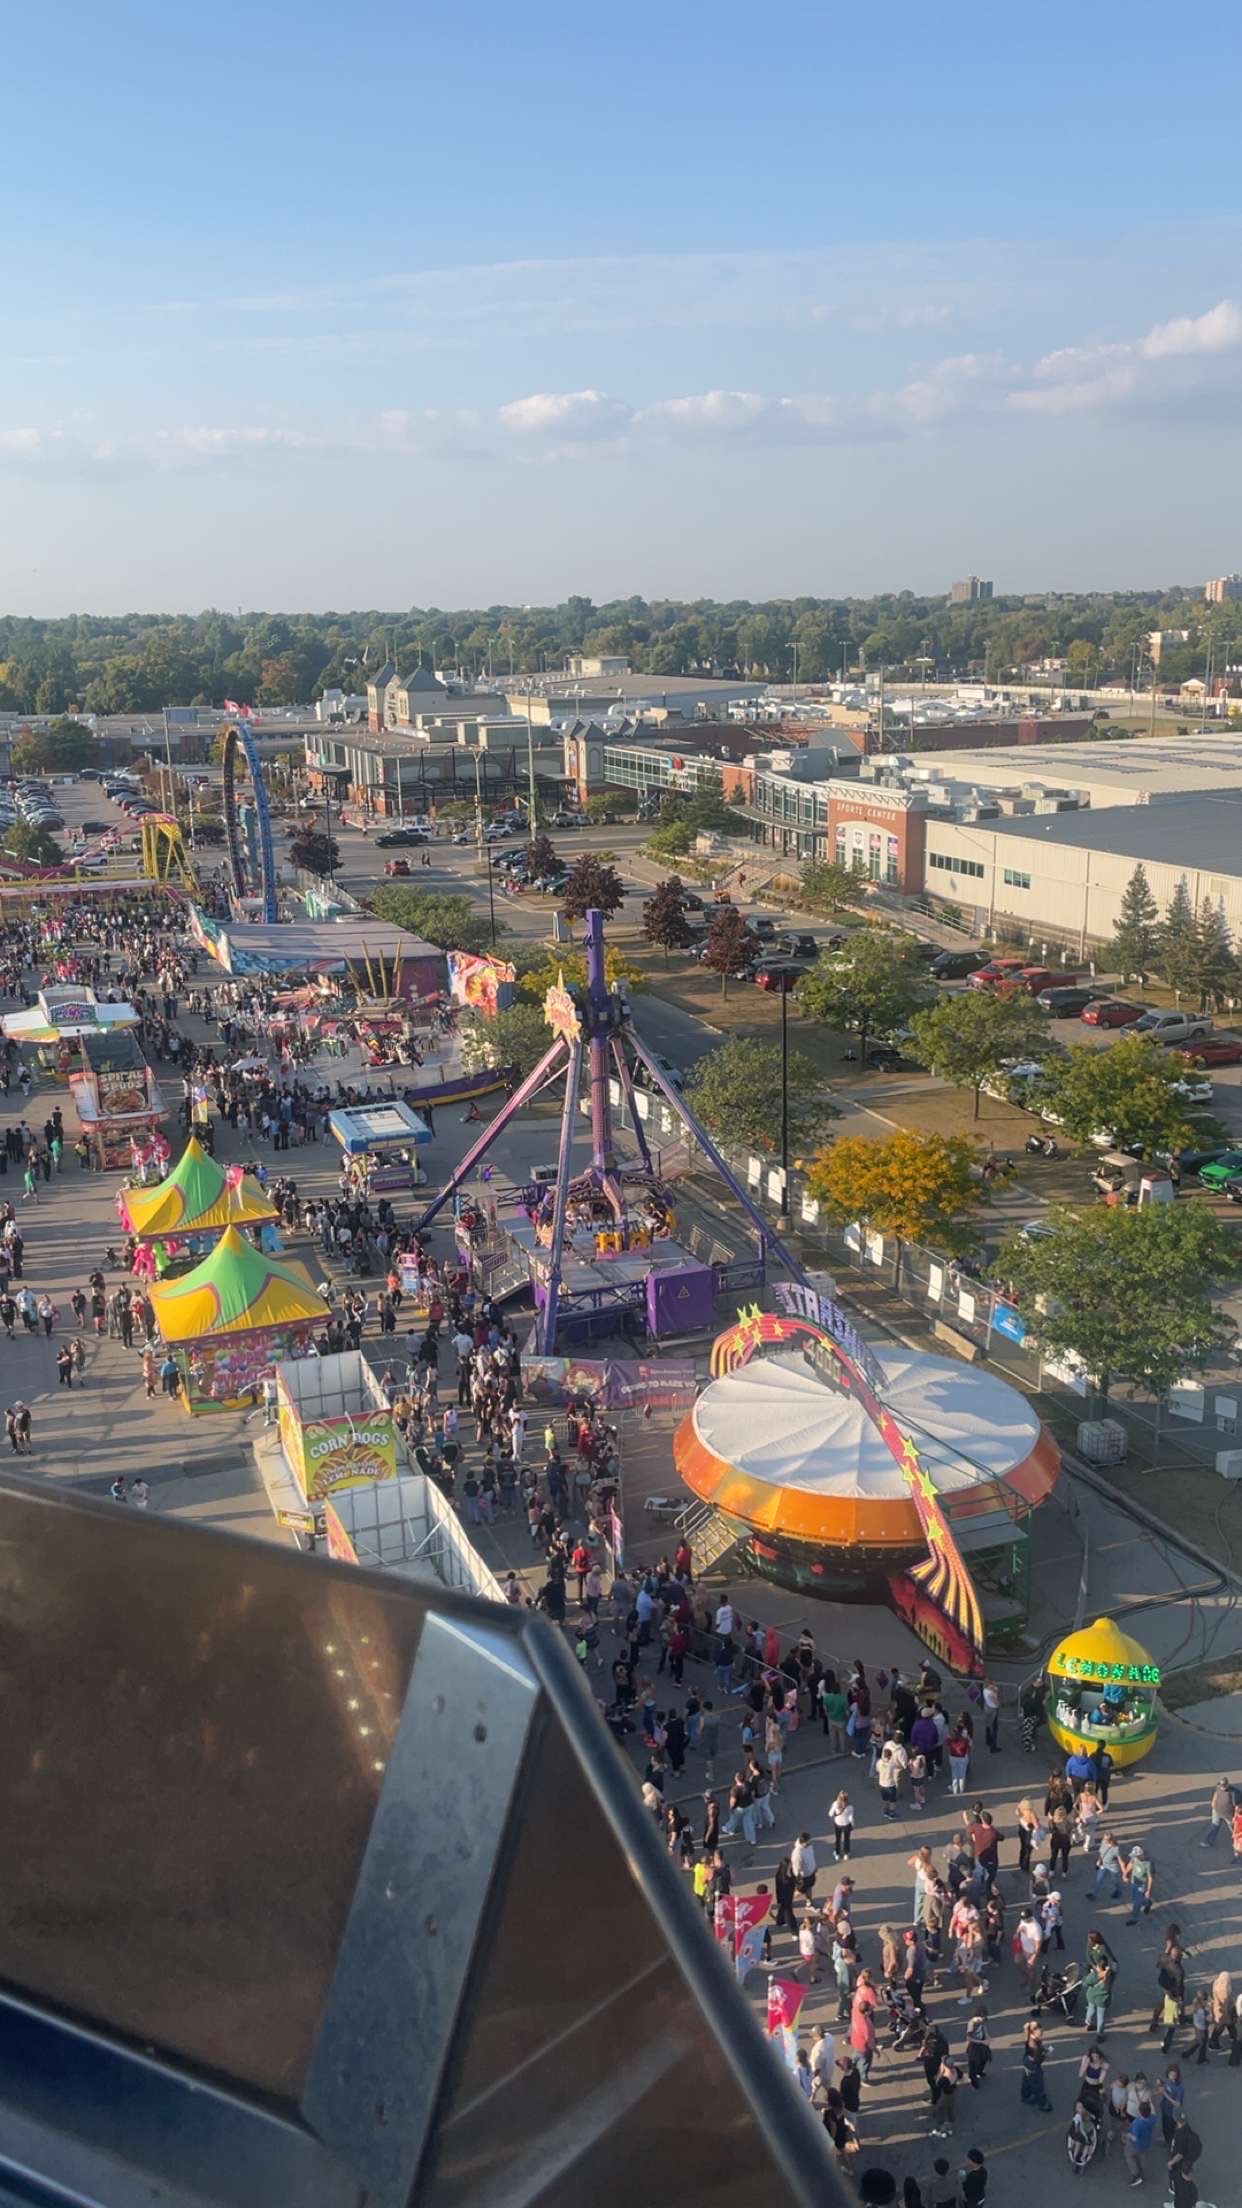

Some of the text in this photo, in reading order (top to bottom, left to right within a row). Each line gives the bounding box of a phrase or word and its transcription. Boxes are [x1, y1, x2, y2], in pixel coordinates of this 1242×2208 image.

[836, 802, 863, 815] SPORTS
[102, 1080, 145, 1092] SPUDS
[310, 1432, 390, 1458] CORN DOGS
[1056, 1653, 1161, 1684] LEMONADE
